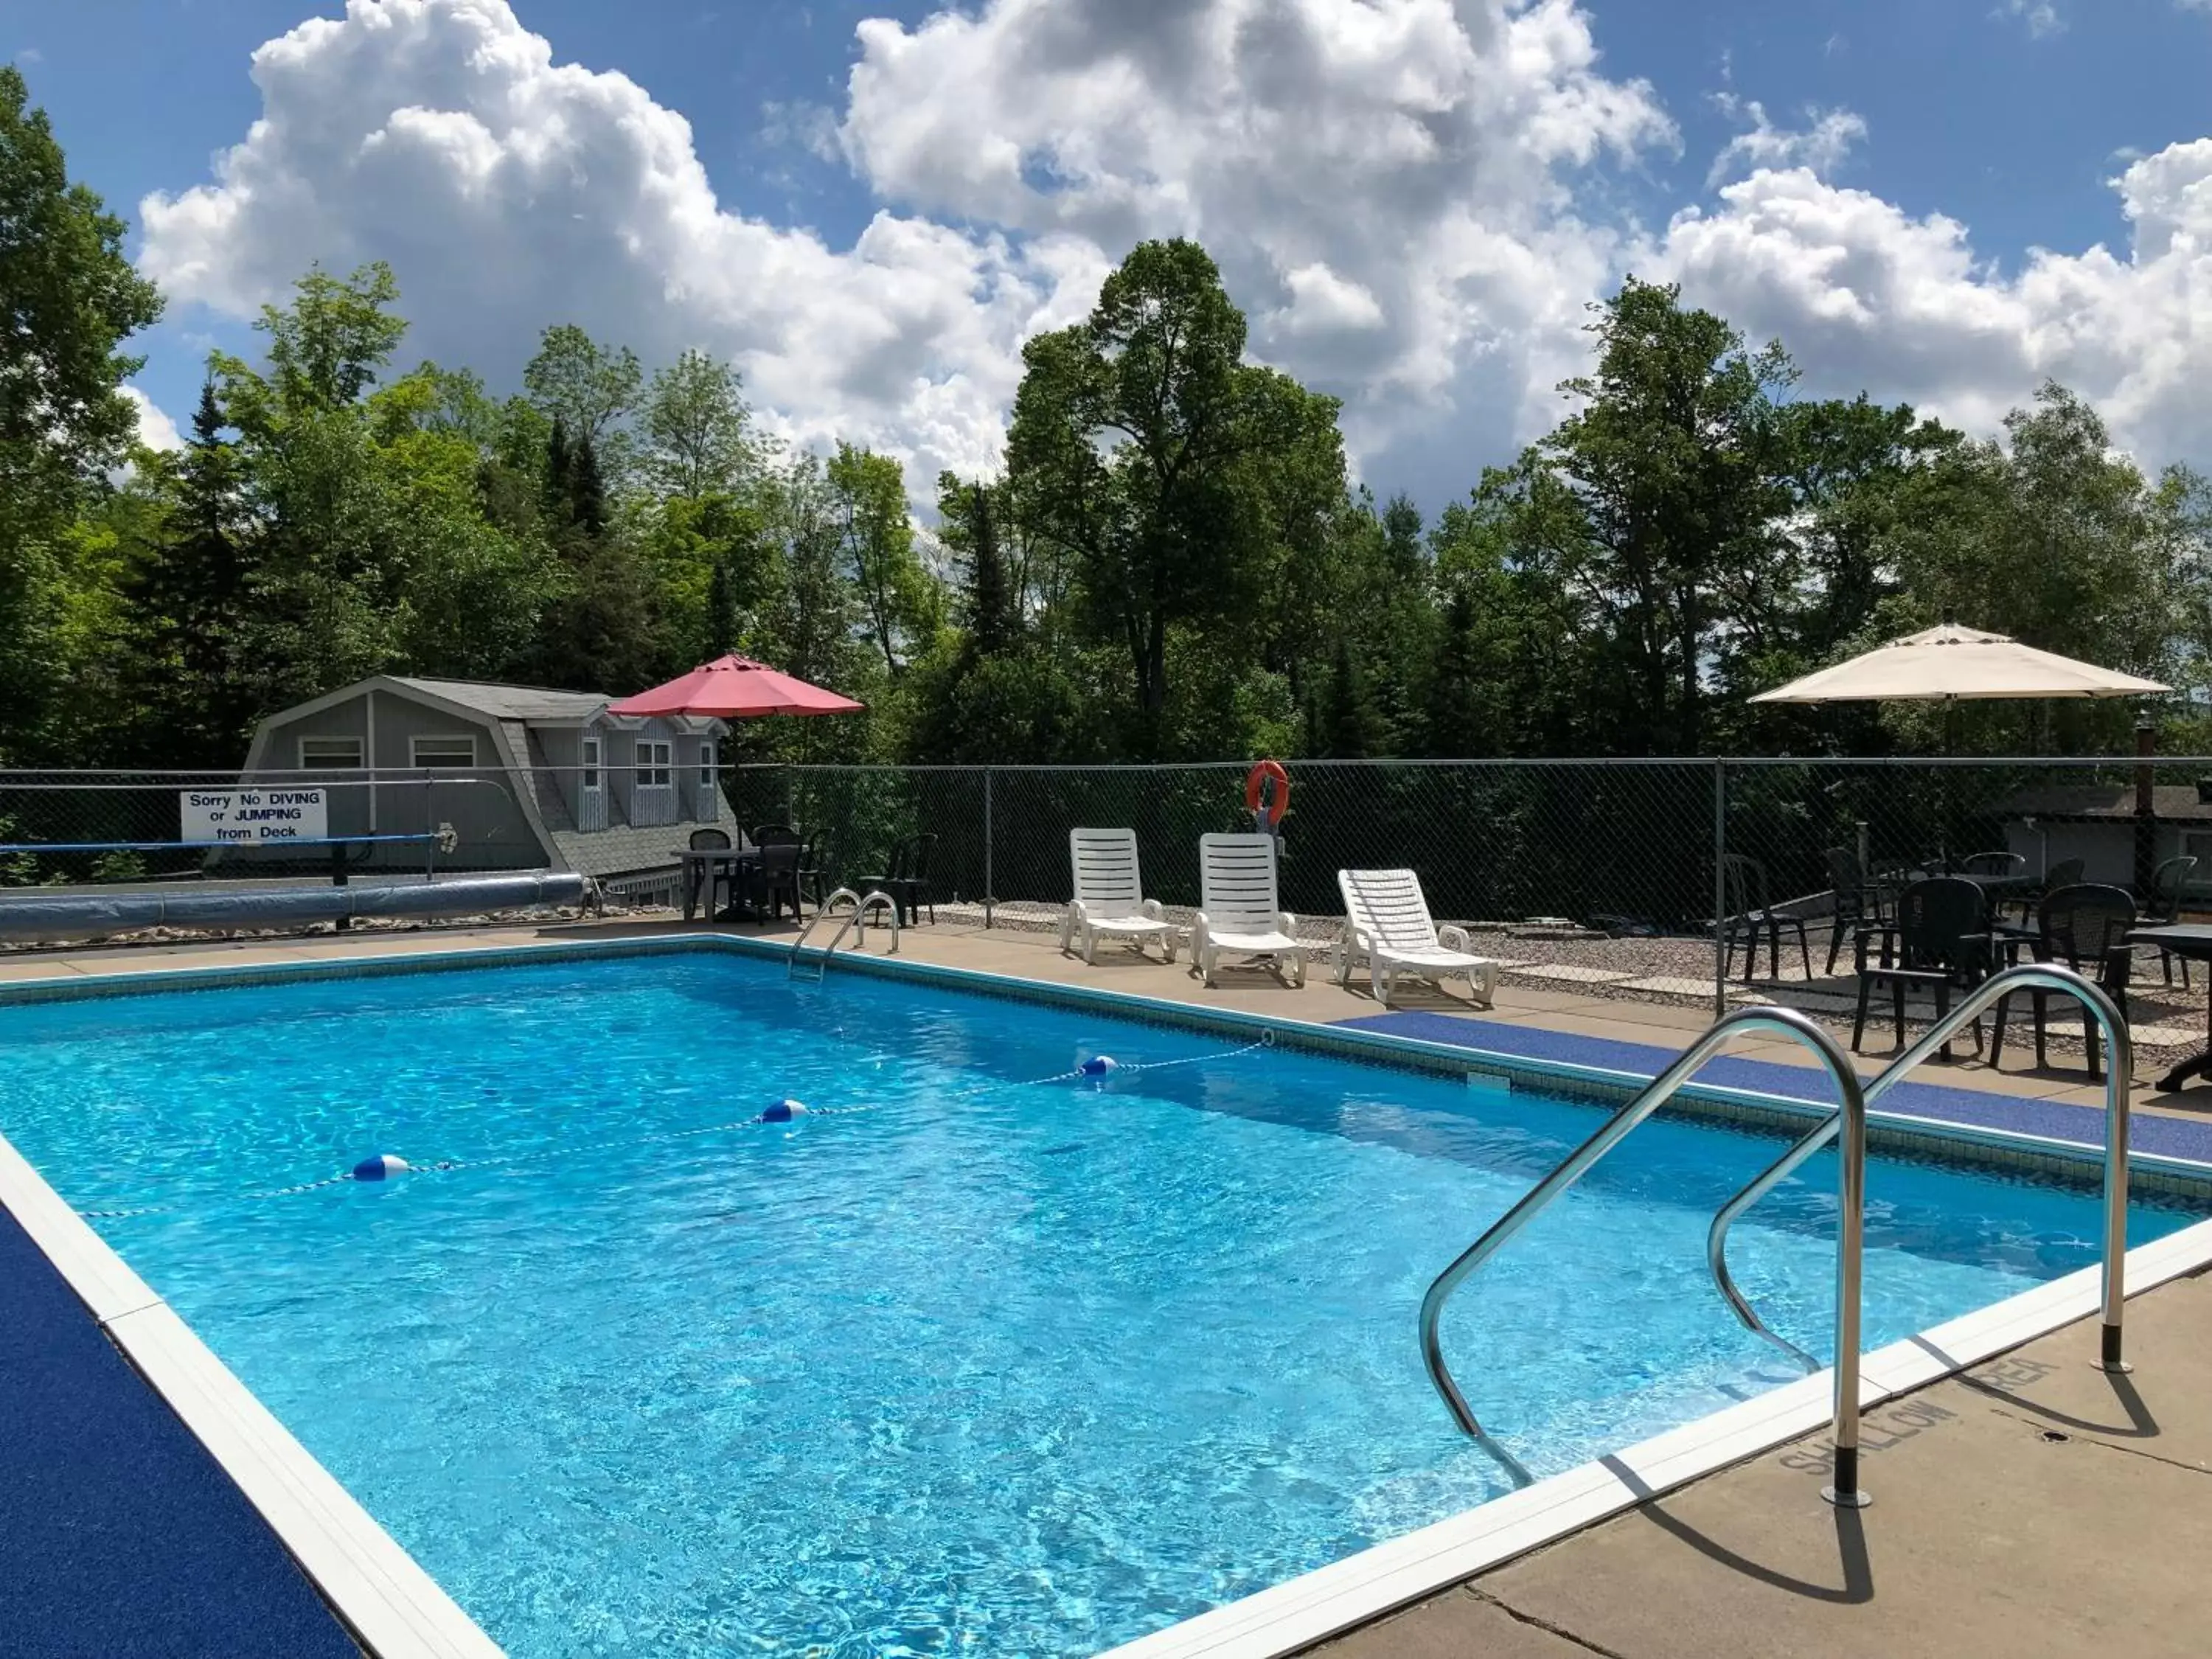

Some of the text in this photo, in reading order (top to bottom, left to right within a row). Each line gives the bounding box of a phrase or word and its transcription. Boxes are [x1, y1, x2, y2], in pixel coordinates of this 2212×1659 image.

[189, 793, 320, 809] Sorry No DIVING
[209, 808, 302, 821] or JUMPING
[216, 826, 297, 839] from Deck
[1779, 1399, 1959, 1475] SHLLOW
